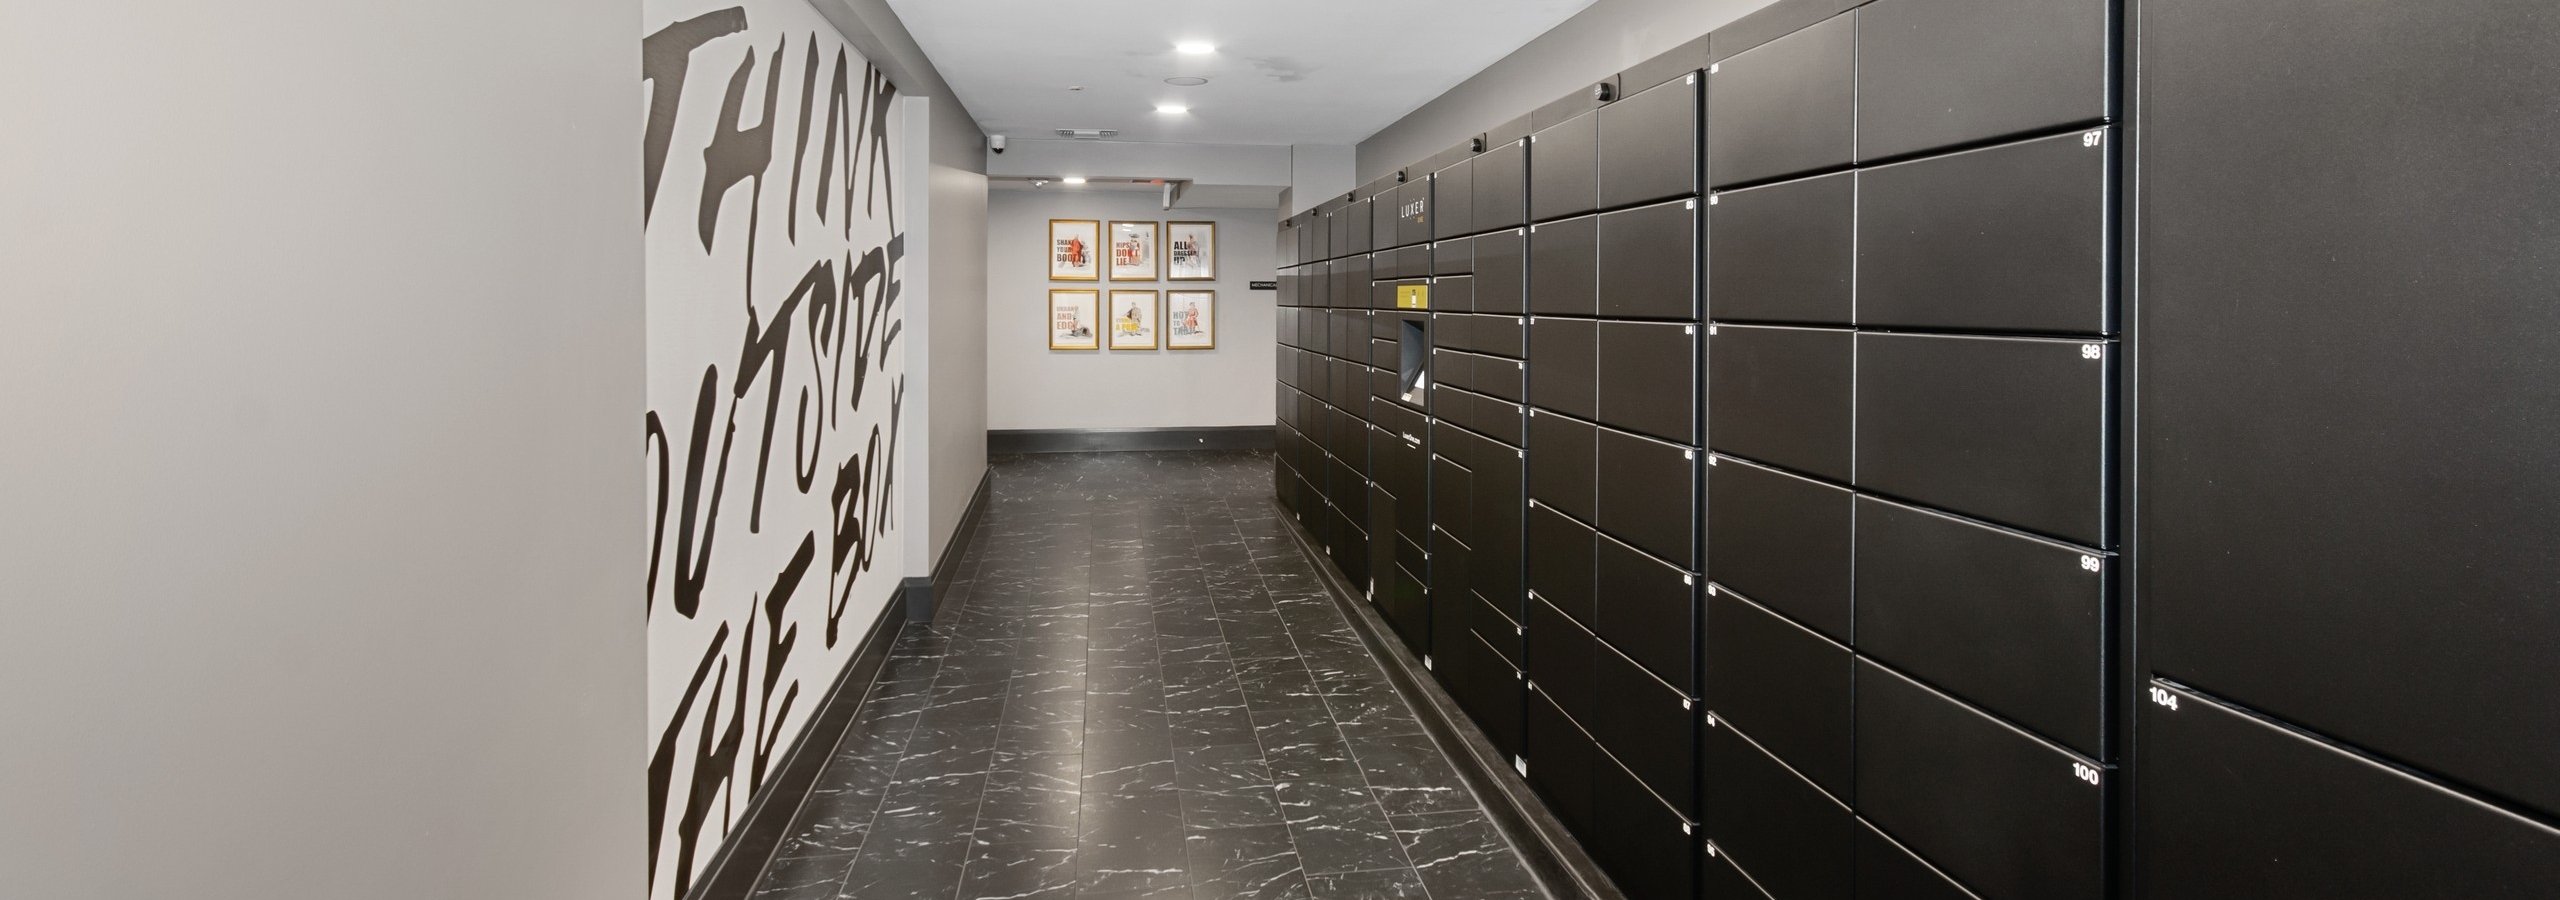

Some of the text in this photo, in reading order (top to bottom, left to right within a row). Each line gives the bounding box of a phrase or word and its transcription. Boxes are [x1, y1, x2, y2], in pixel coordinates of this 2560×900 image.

[2083, 131, 2102, 147] 97
[643, 6, 896, 300] THINK
[1401, 200, 1424, 218] LUXER
[1174, 241, 1187, 250] ALL
[1116, 257, 1127, 265] LIE
[1174, 257, 1186, 265] UP
[1173, 311, 1188, 319] HOT
[2082, 344, 2101, 359] 98
[646, 232, 905, 627] OUTSIDE
[2081, 555, 2100, 572] 99
[648, 372, 904, 900] THE BOX
[2149, 687, 2178, 710] 104
[2073, 762, 2099, 785] 100
